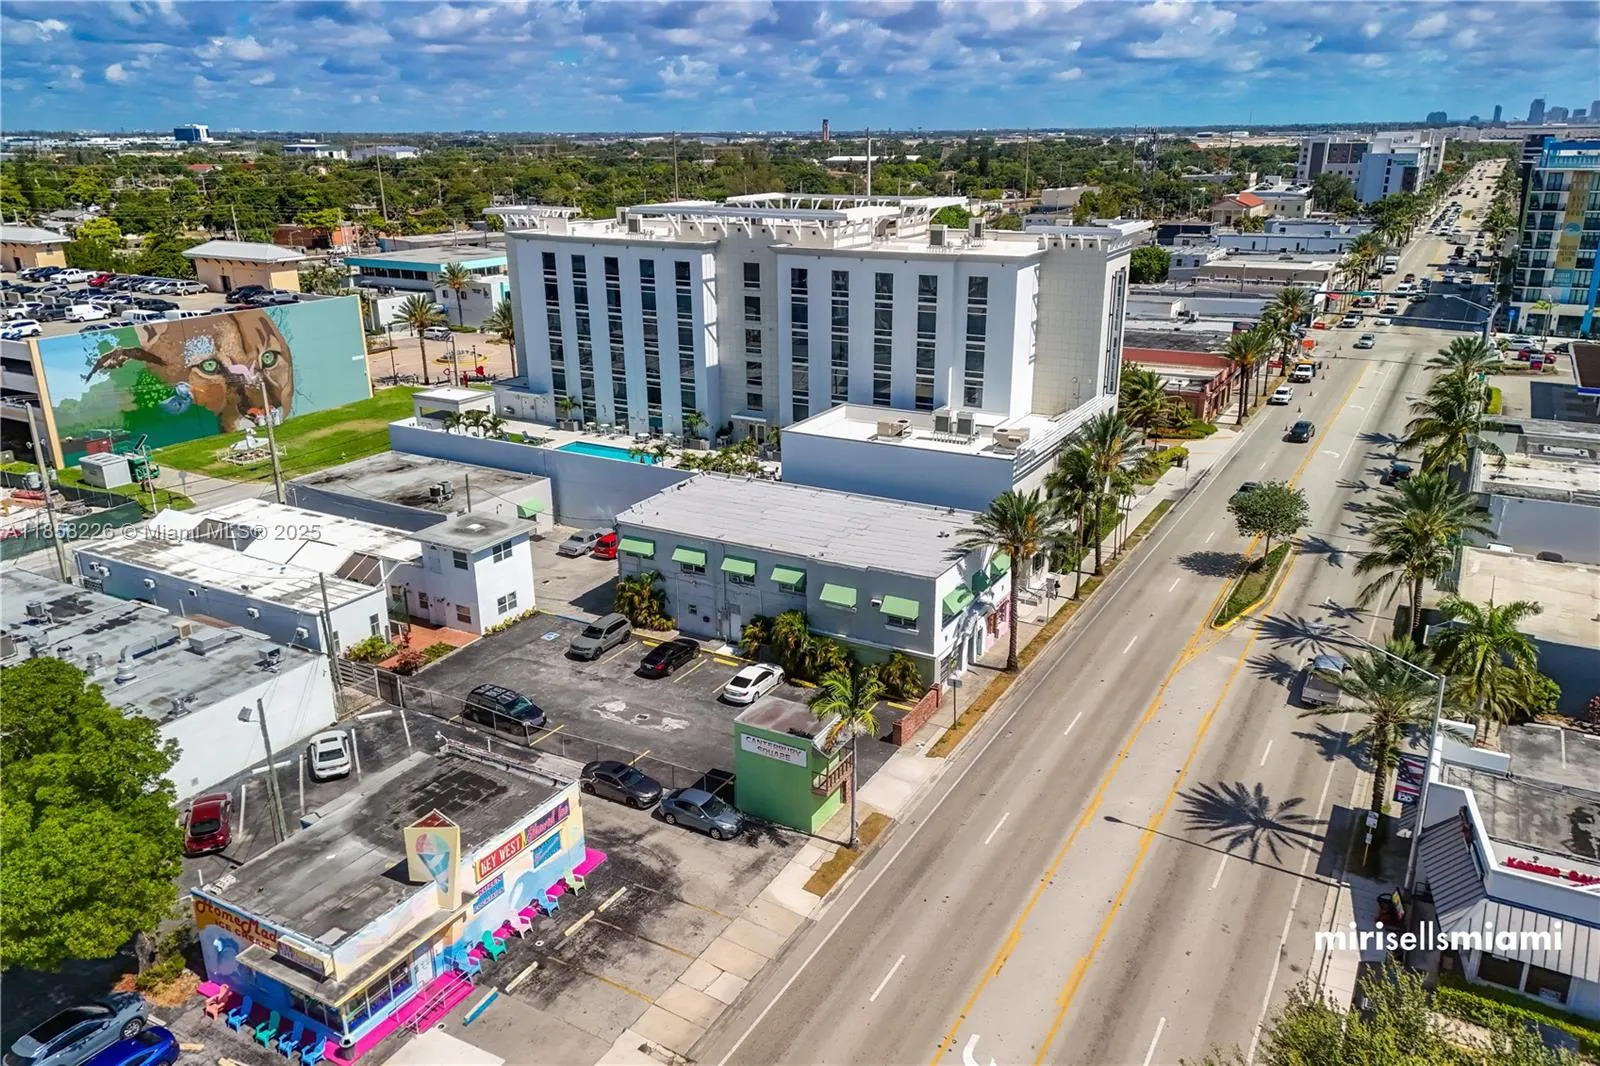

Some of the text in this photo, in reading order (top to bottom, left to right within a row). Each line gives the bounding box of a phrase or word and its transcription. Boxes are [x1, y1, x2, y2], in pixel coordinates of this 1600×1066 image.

[757, 745, 791, 762] SQUARE
[480, 852, 496, 876] KEY
[499, 835, 521, 862] WEST
[214, 919, 233, 934] ICE
